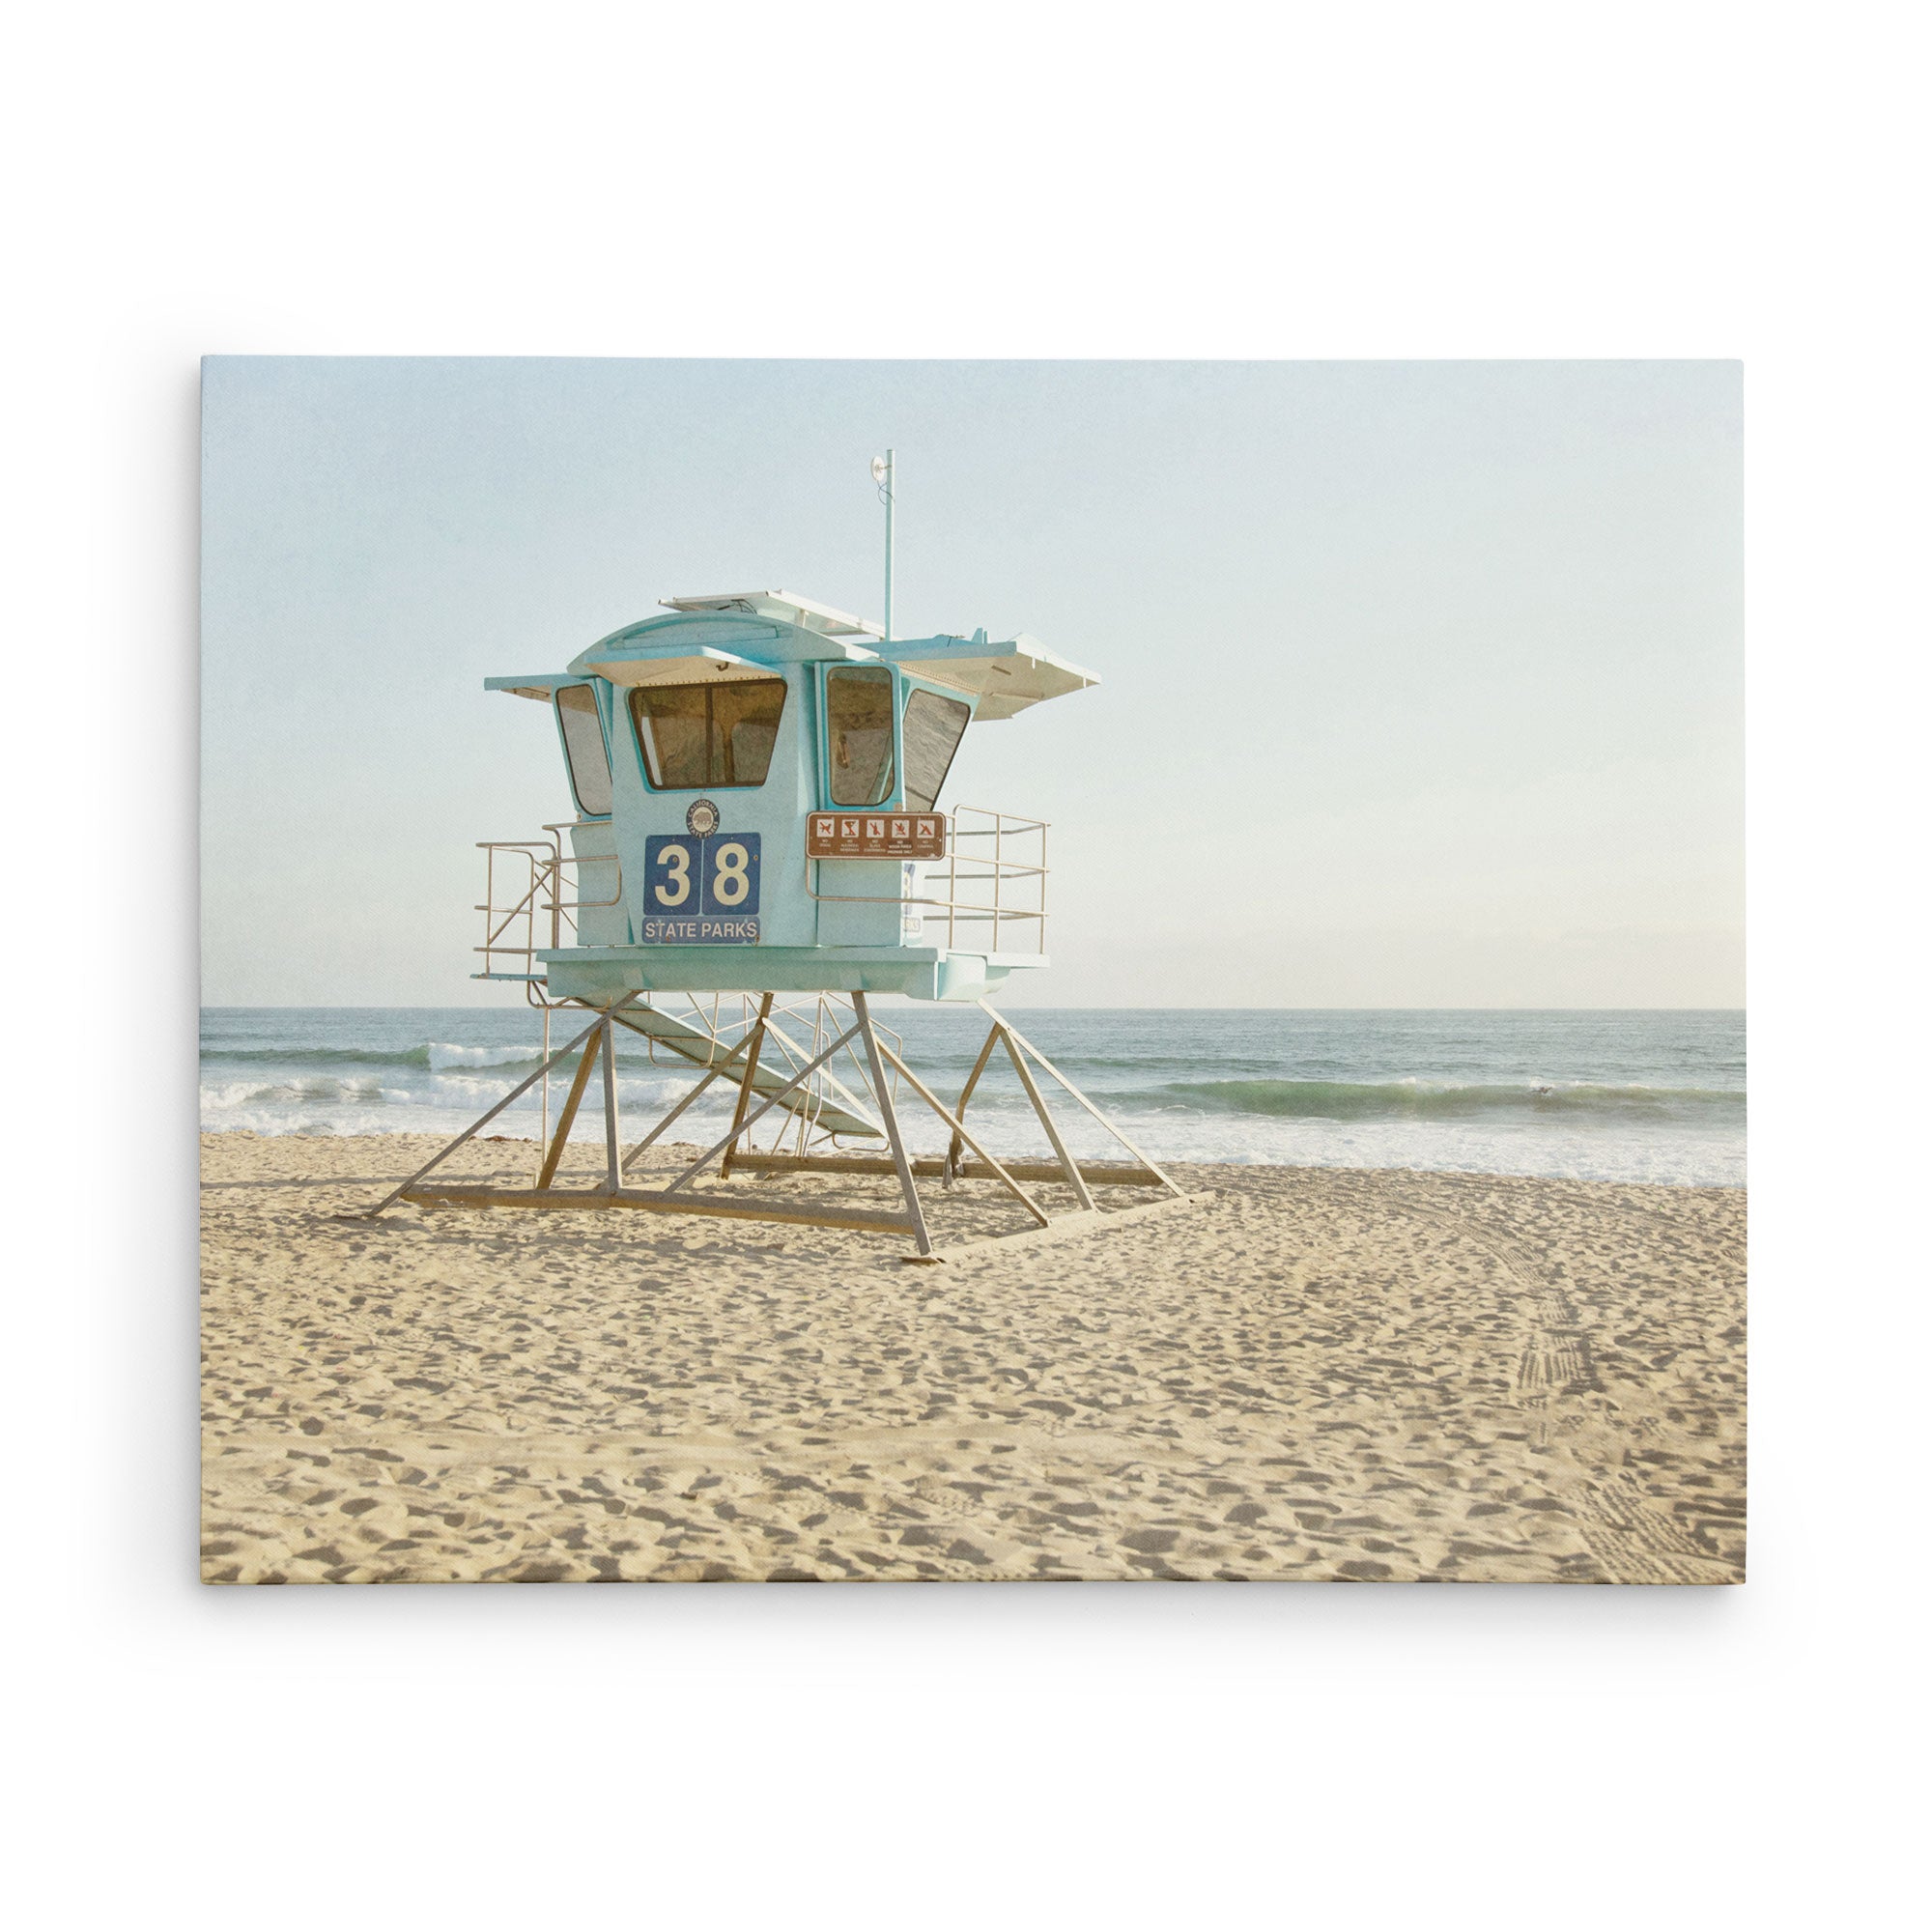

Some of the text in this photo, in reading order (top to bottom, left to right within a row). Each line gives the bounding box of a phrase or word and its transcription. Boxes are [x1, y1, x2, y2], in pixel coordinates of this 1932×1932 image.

[688, 800, 718, 817] CALIFORNIA
[687, 821, 702, 838] STATE
[645, 922, 757, 938] STATE PARKS
